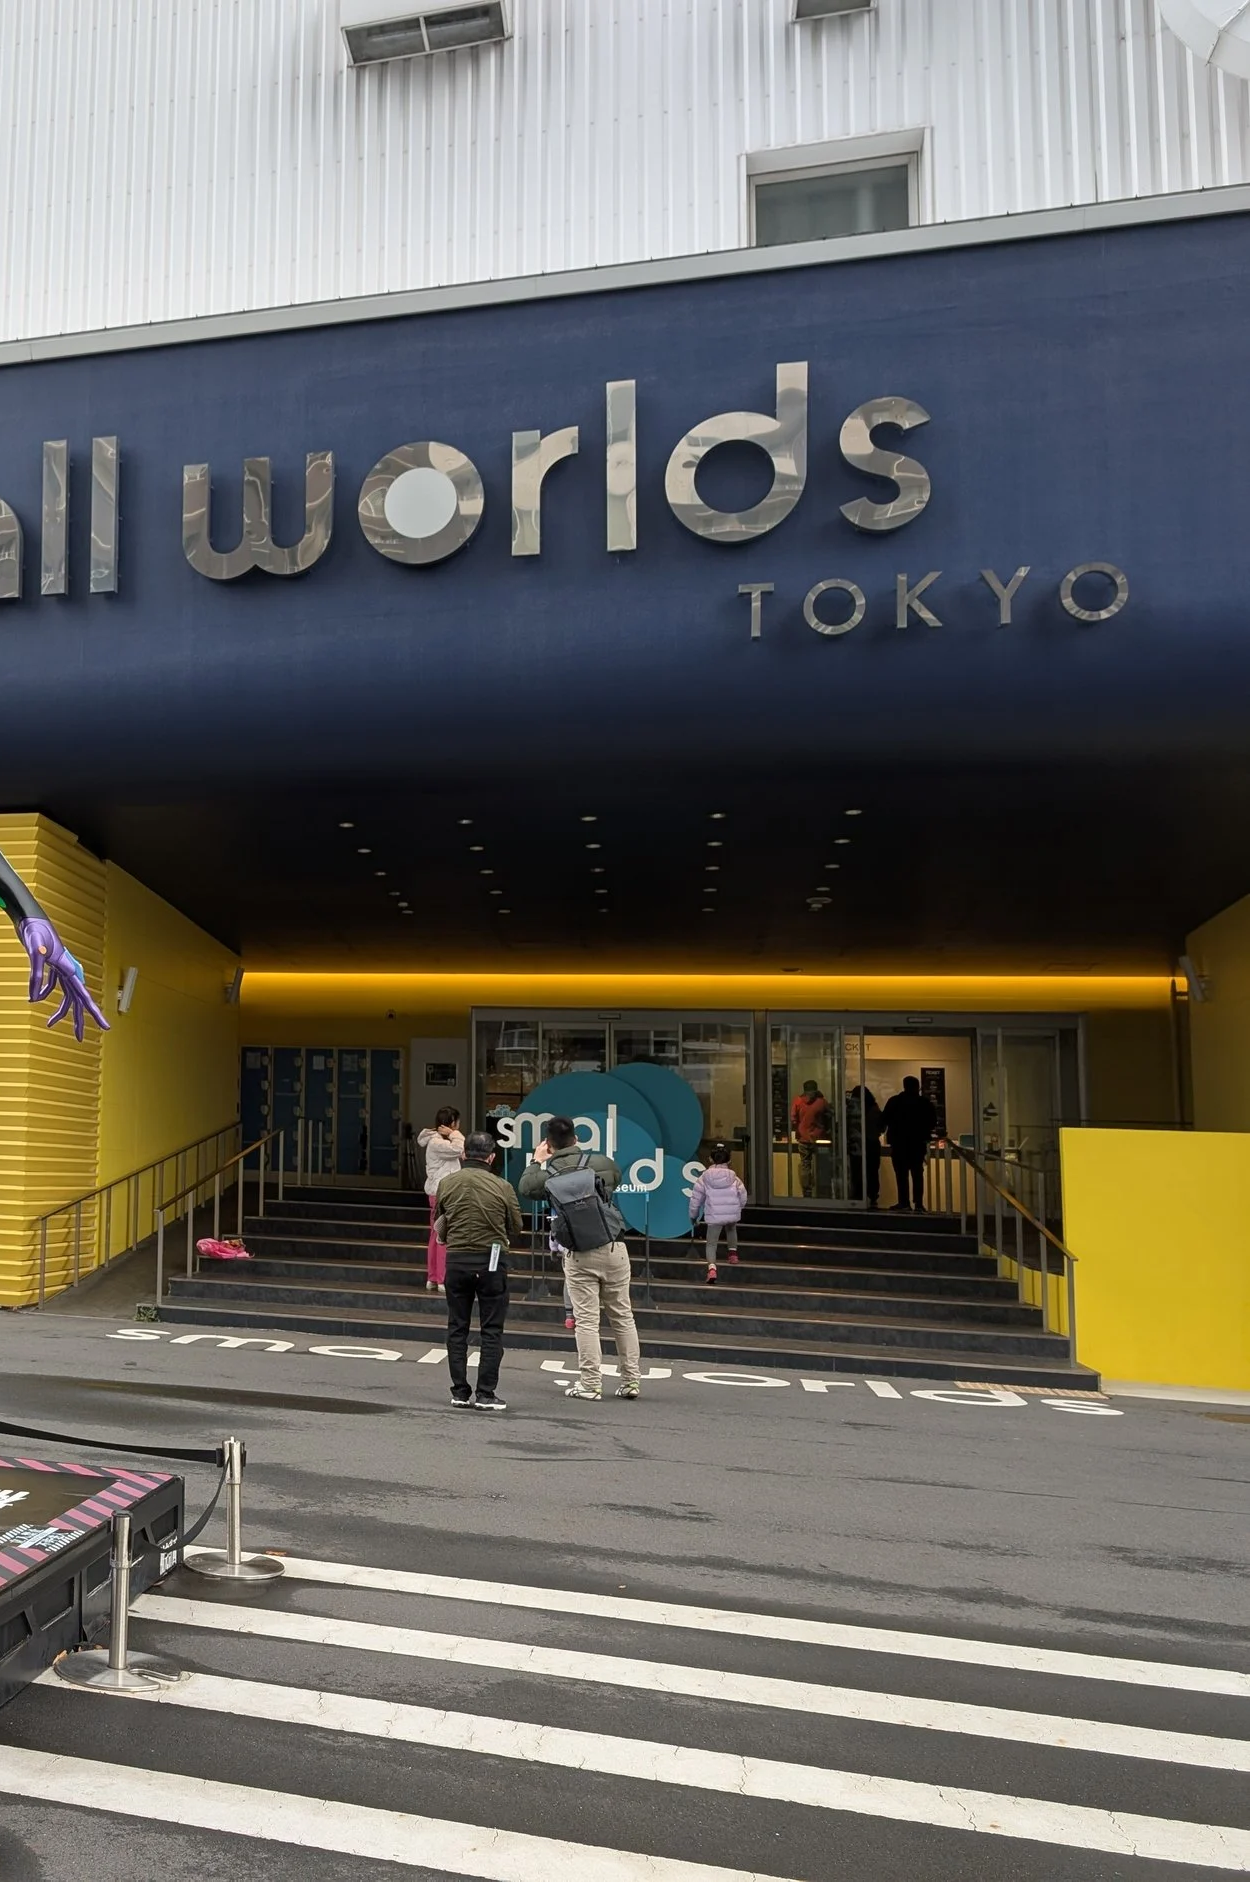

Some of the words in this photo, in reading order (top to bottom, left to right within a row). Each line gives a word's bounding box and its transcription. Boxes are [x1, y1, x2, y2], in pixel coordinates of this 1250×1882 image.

[182, 361, 931, 580] worlds
[737, 562, 1129, 638] TOKYO
[614, 1184, 647, 1193] seum
